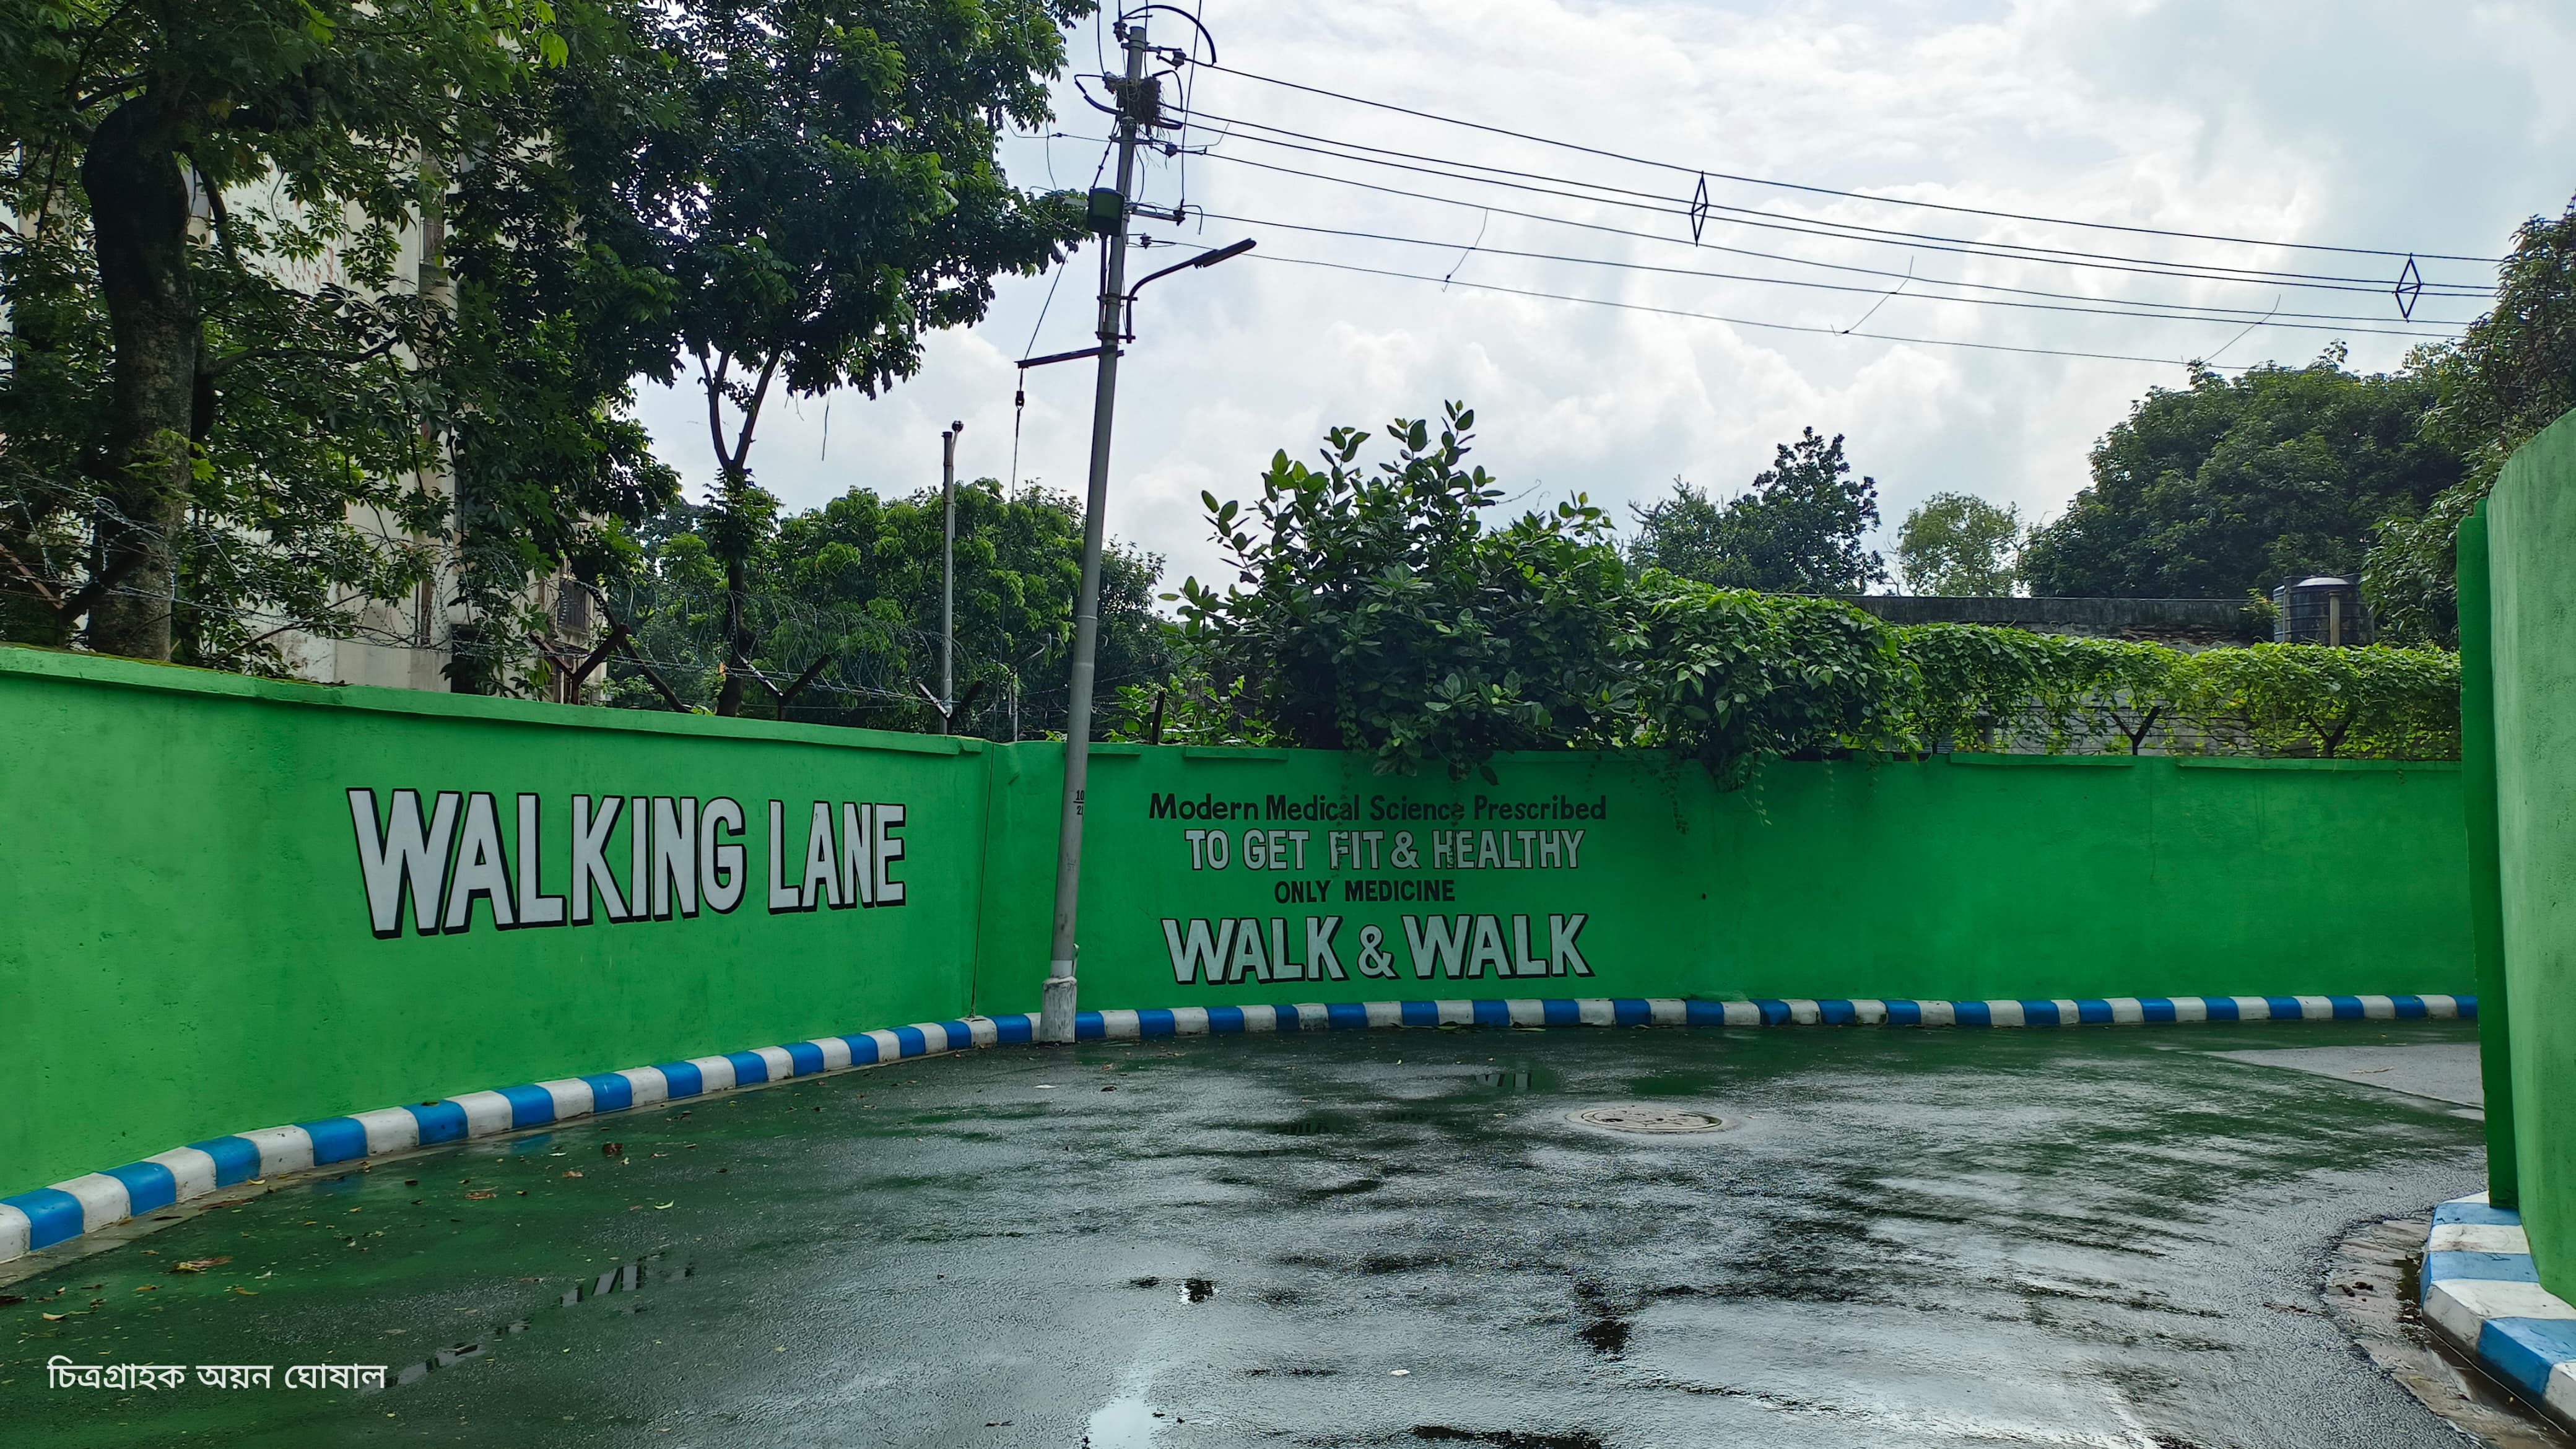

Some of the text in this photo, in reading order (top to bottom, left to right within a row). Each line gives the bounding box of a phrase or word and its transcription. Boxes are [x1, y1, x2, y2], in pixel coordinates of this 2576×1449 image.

[1076, 790, 1084, 801] 10
[1149, 793, 1607, 820] Modern Medical Science Prescribed
[346, 788, 907, 939] WALKING LANE
[1184, 829, 1586, 871] TO GET FIT & HEALTHY
[1274, 879, 1456, 904] ONLY MEDICINE
[1160, 913, 1596, 985] WALK & WALK
